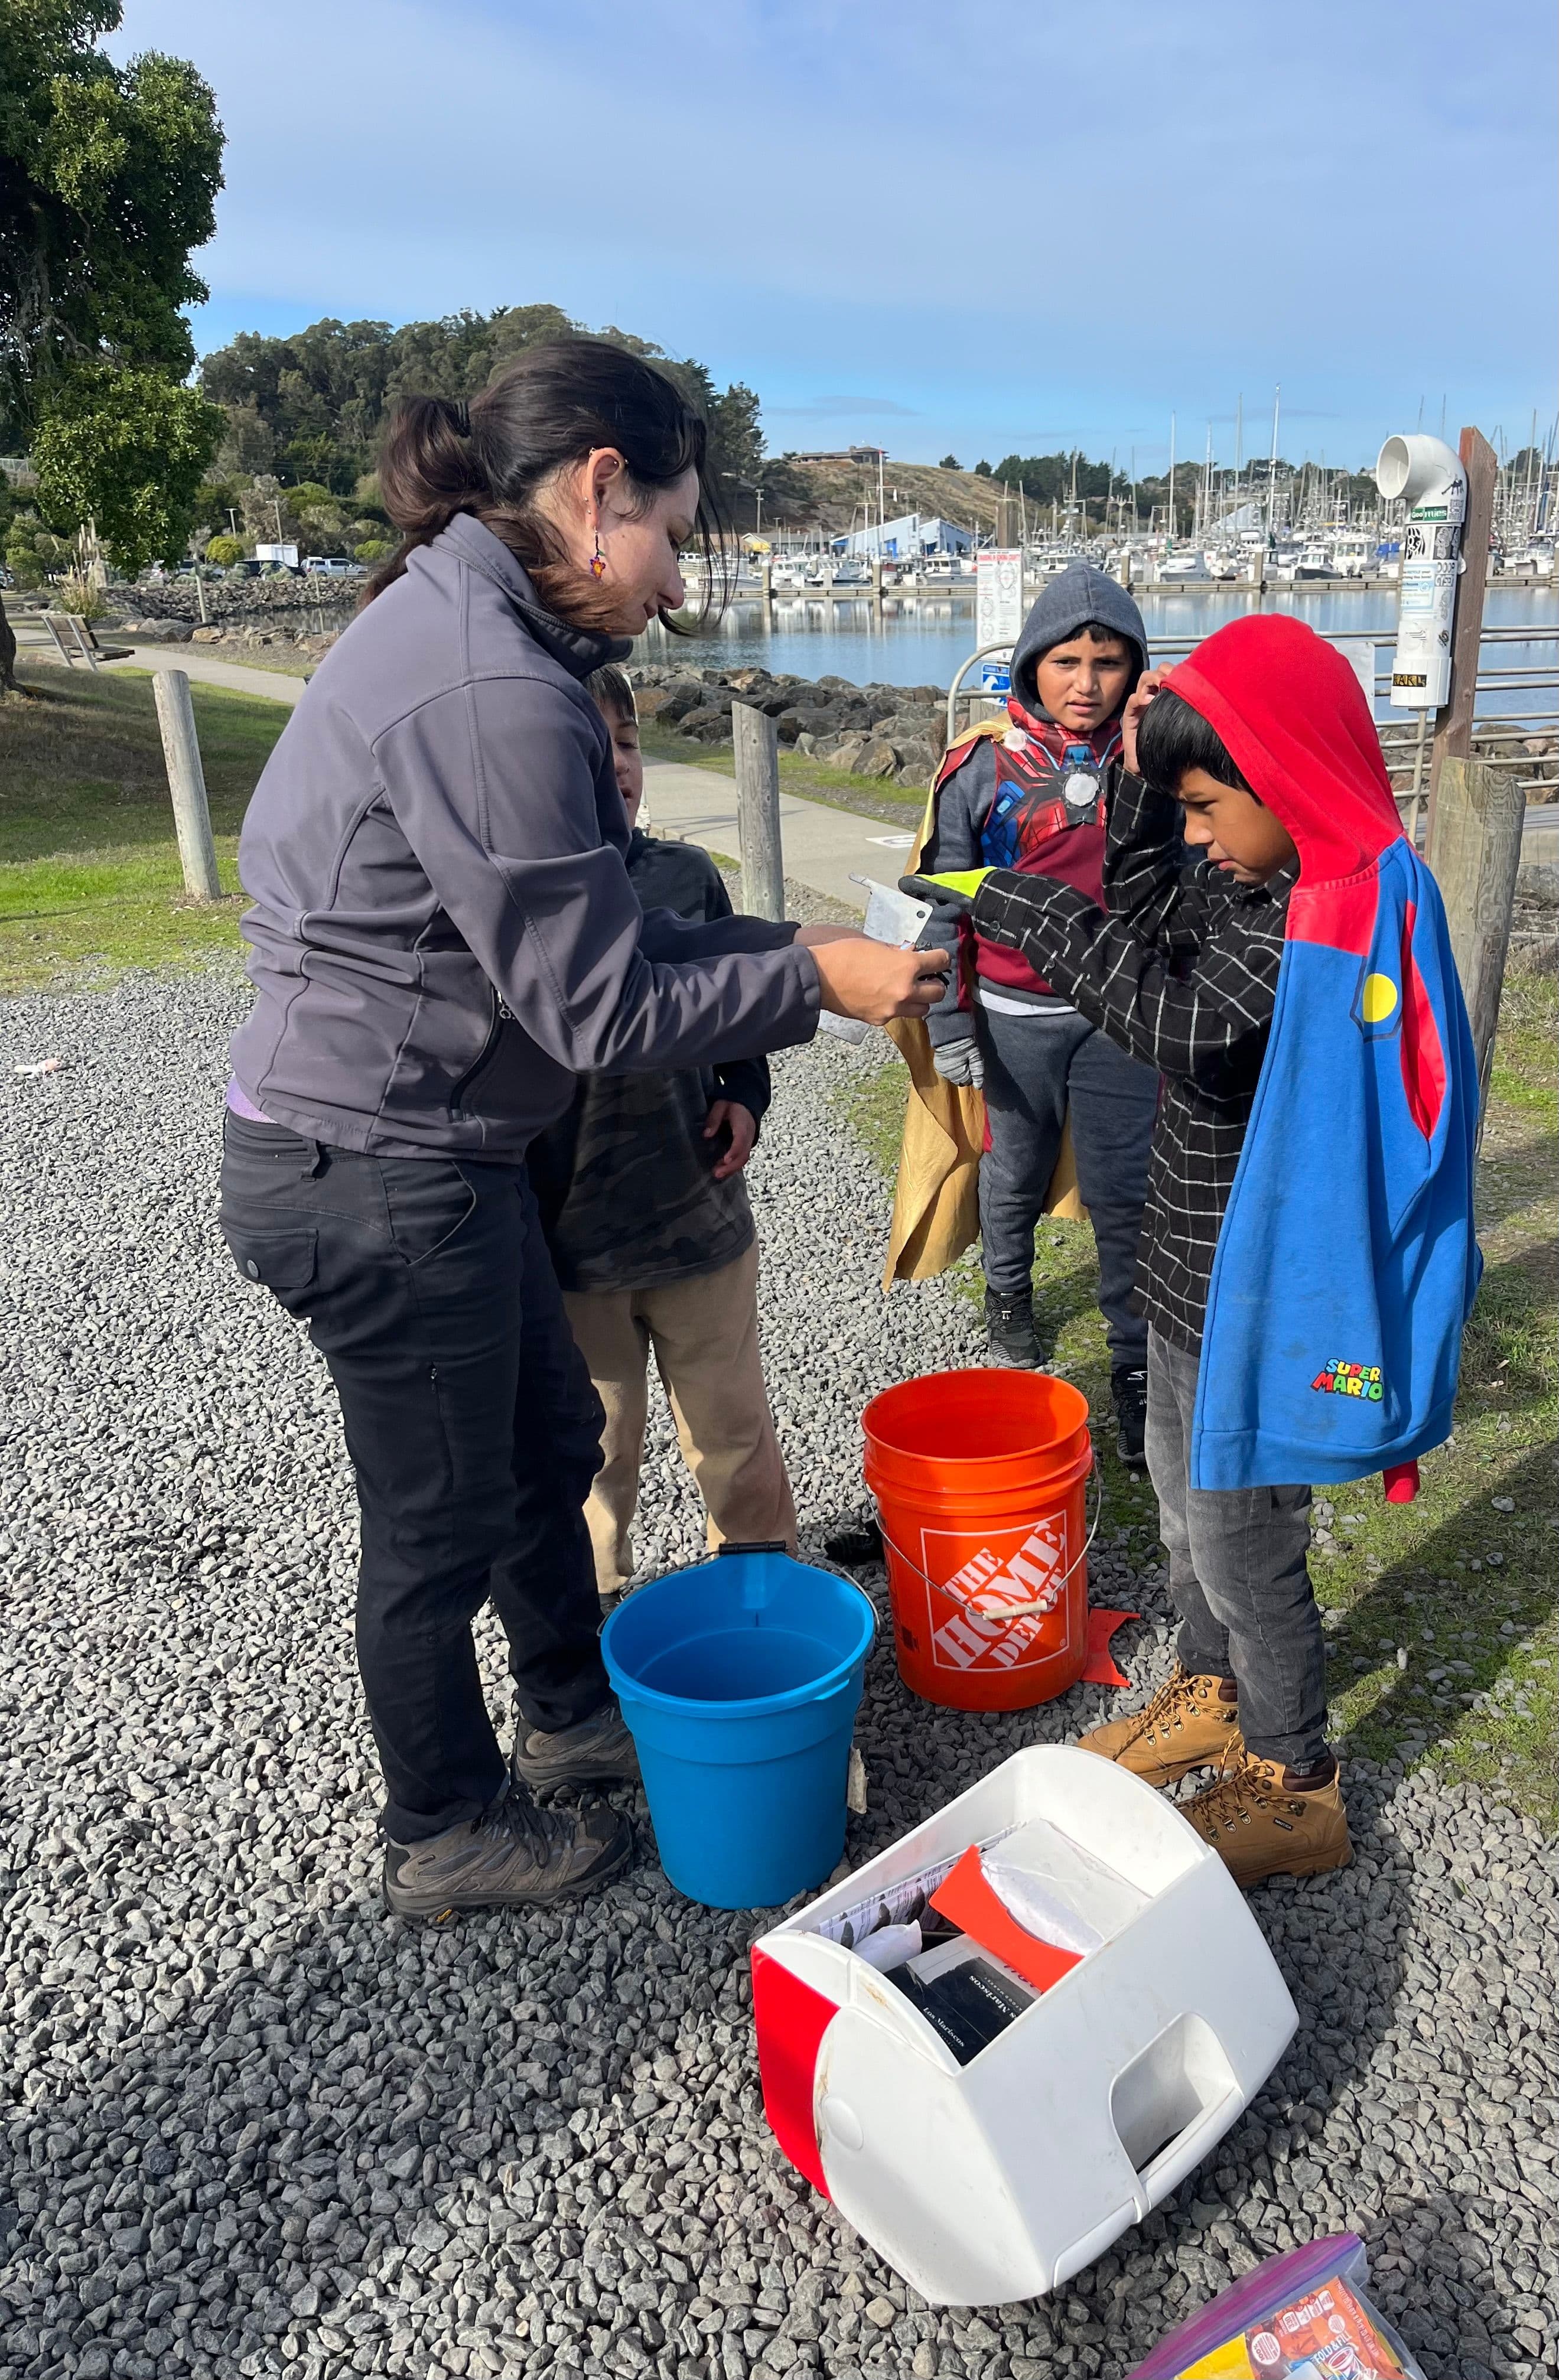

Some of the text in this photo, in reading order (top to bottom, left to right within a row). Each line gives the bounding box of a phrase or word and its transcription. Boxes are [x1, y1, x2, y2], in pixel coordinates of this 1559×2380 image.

[1325, 1358, 1381, 1382] SUPER
[1311, 1371, 1384, 1402] MARIO
[941, 1548, 1004, 1603] THE
[933, 1521, 1066, 1668] HOME
[990, 1568, 1065, 1668] DEPOT
[1275, 1819, 1291, 1829] NAUTICA
[969, 1975, 1010, 2013] Mariscos
[984, 1977, 1004, 1995] MARKET
[1005, 1995, 1022, 2011] AFOOD
[923, 2007, 935, 2021] Los
[935, 2018, 965, 2047] Mariscos
[1284, 2316, 1295, 2329] 330
[1253, 2343, 1265, 2362] 100%
[1313, 2330, 1353, 2364] FOLD & FILL
